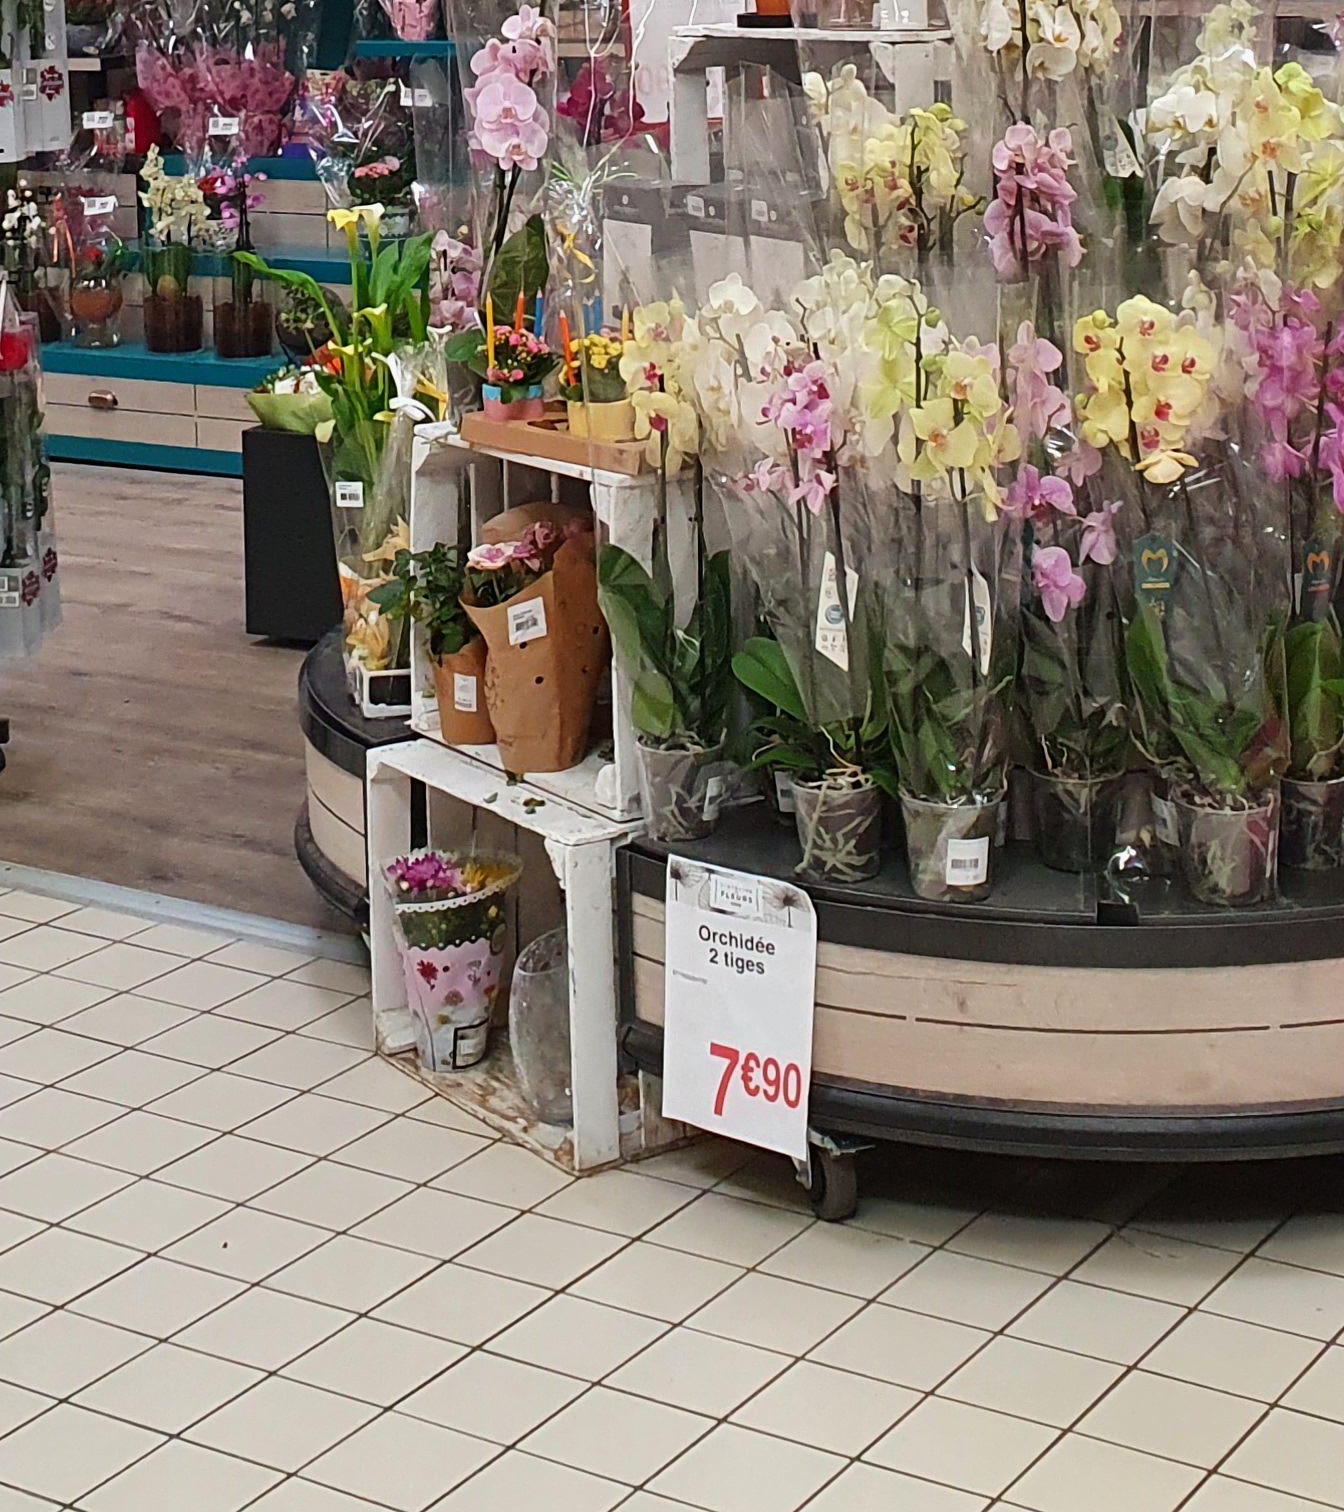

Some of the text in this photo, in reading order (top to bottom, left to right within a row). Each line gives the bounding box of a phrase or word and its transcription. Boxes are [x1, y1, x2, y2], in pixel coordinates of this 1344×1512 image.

[698, 925, 776, 955] Orchidée
[709, 948, 766, 975] 2 tiges
[709, 1041, 802, 1117] 7€90
